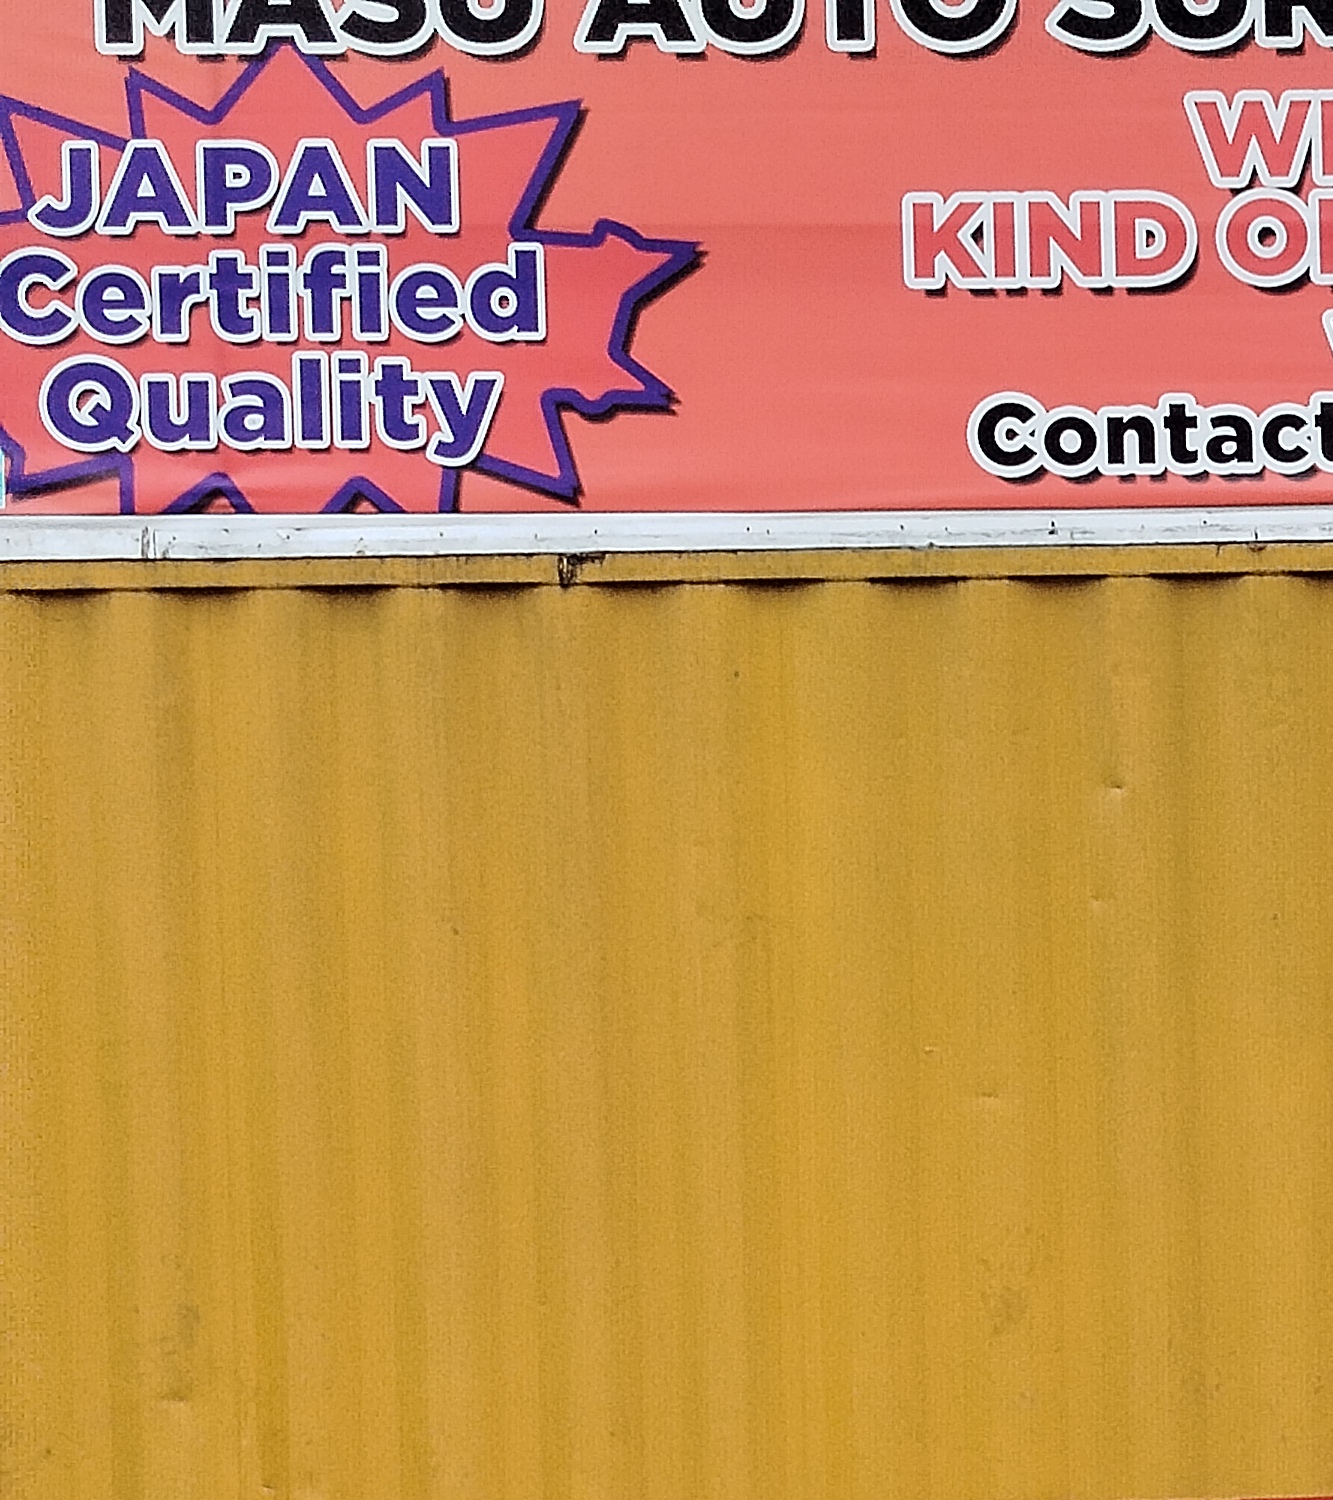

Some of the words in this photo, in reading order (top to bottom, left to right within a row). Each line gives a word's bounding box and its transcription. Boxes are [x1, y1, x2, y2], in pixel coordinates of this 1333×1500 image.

[33, 140, 460, 235] JAPAN
[904, 190, 1196, 289] KIND
[0, 243, 544, 343] Certified
[41, 355, 502, 465] Quality
